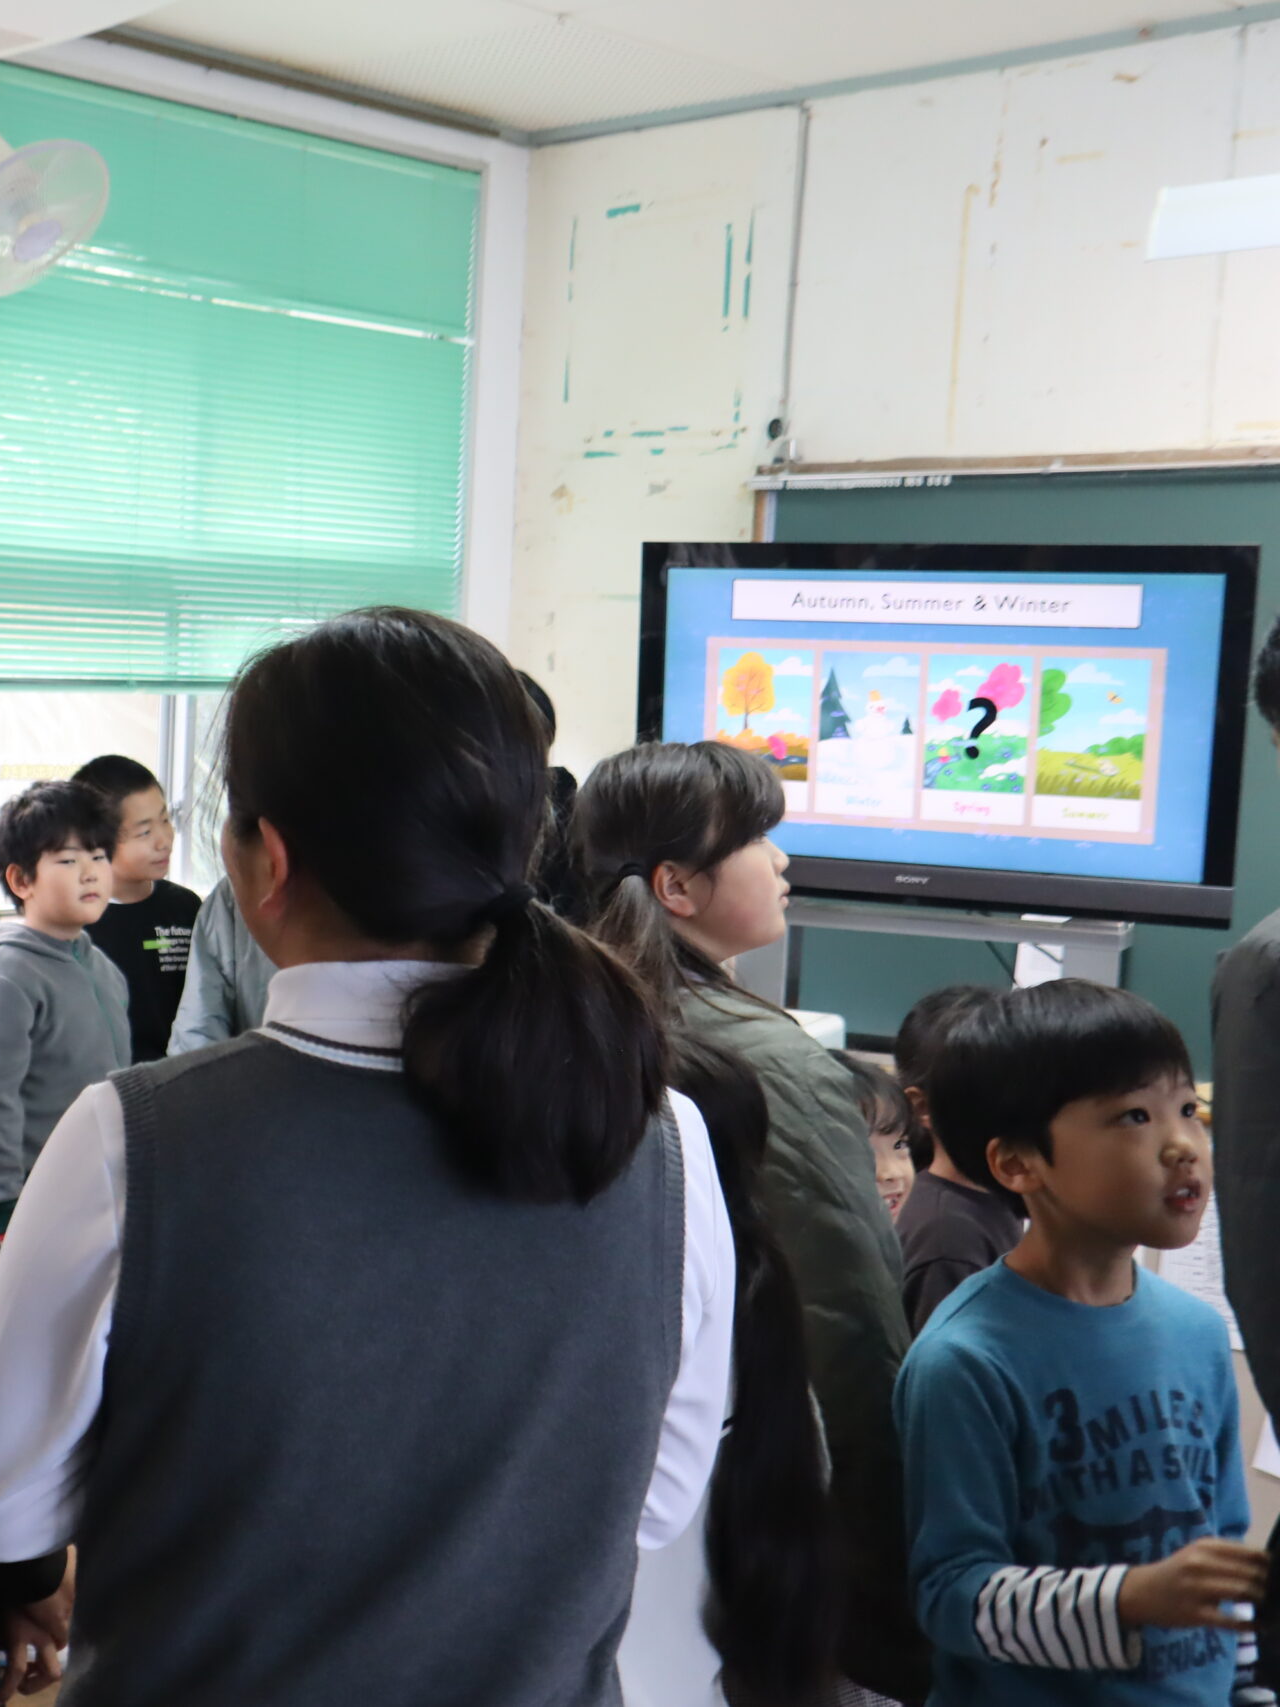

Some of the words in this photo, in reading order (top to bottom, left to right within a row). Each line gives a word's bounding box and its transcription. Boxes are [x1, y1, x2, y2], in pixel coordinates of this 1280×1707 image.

[791, 591, 875, 612] Autumn,
[880, 593, 965, 612] Summer
[972, 595, 987, 612] &
[994, 595, 1071, 614] Winter
[952, 801, 991, 816] Spring
[894, 874, 931, 885] SONY
[1044, 1388, 1085, 1463] 3
[1086, 1389, 1204, 1457] MILES
[1129, 1449, 1156, 1487] A
[1144, 1626, 1228, 1674] ERICA
